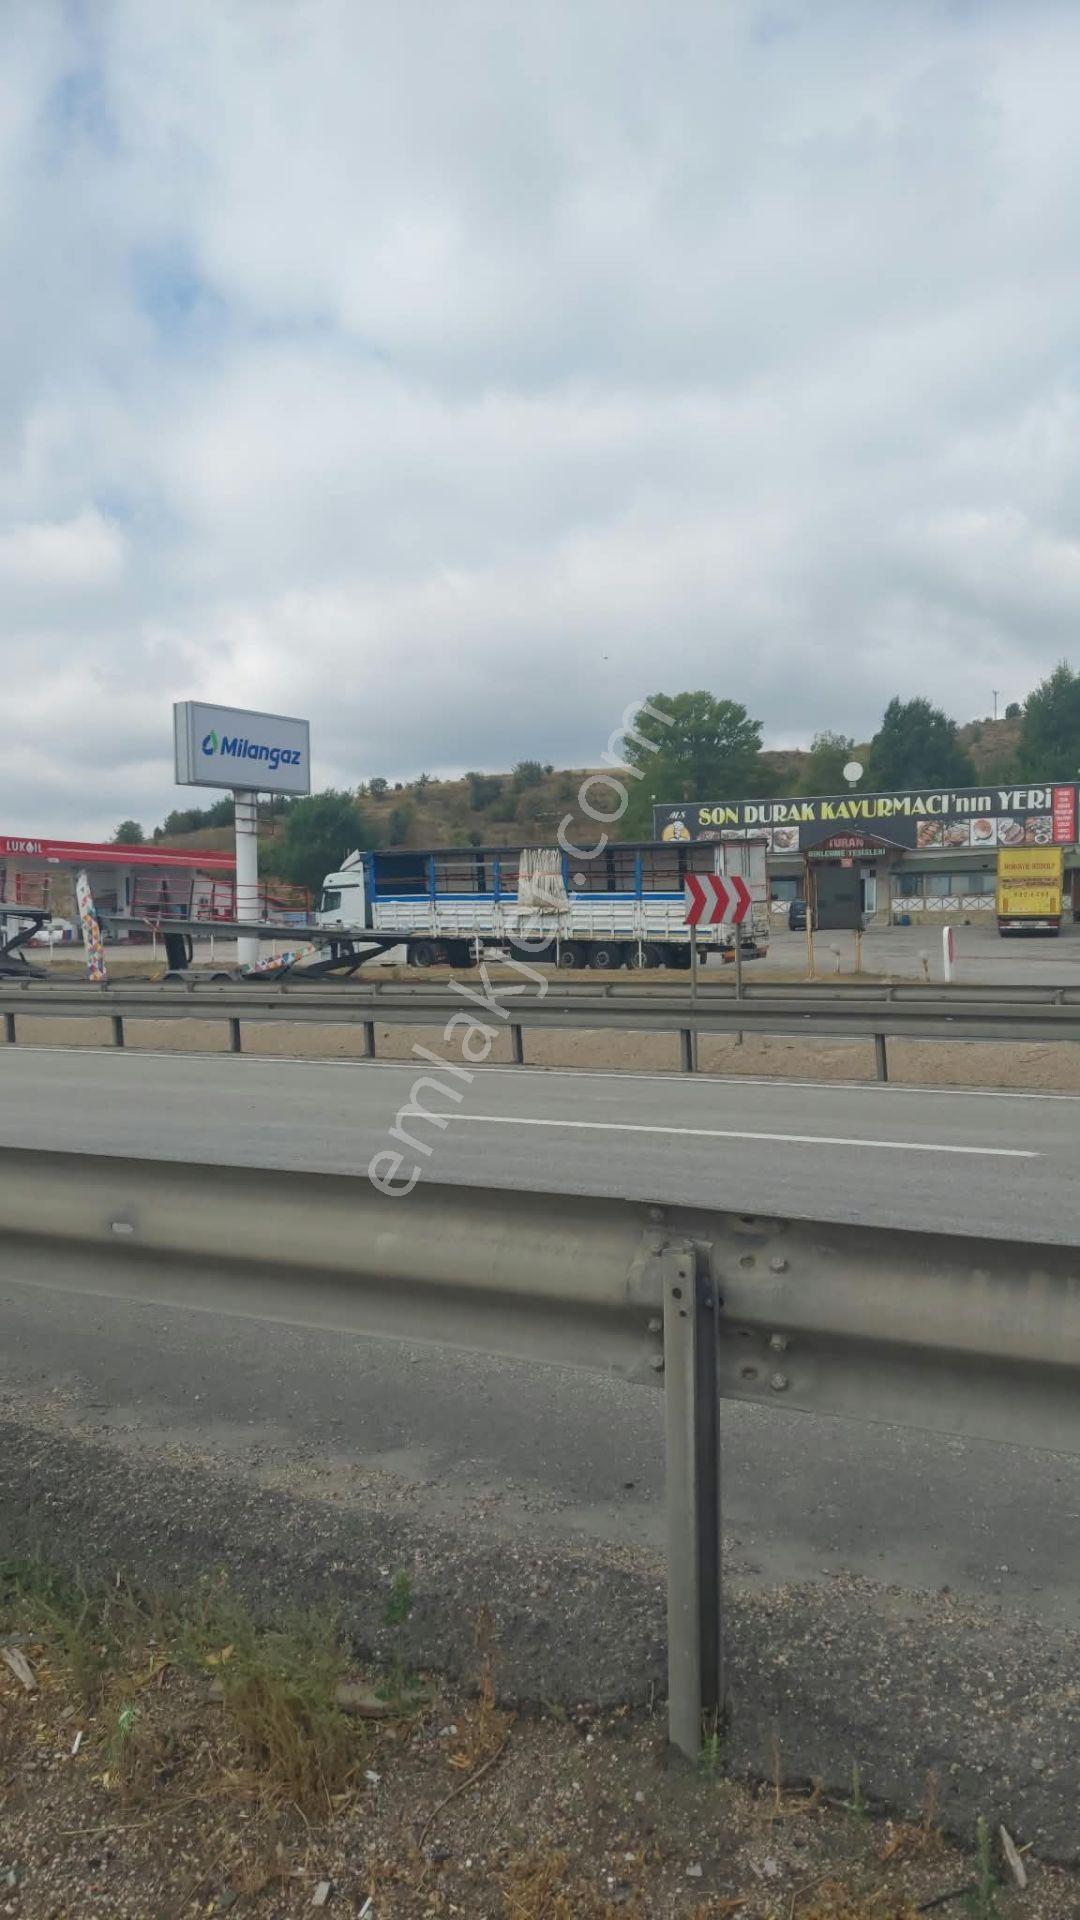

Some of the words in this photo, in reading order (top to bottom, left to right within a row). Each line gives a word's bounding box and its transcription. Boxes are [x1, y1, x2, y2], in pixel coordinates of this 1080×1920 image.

[220, 735, 301, 769] Milangaz
[698, 806, 739, 826] SON
[744, 803, 816, 823] DURAK
[6, 839, 43, 854] LUKOIL
